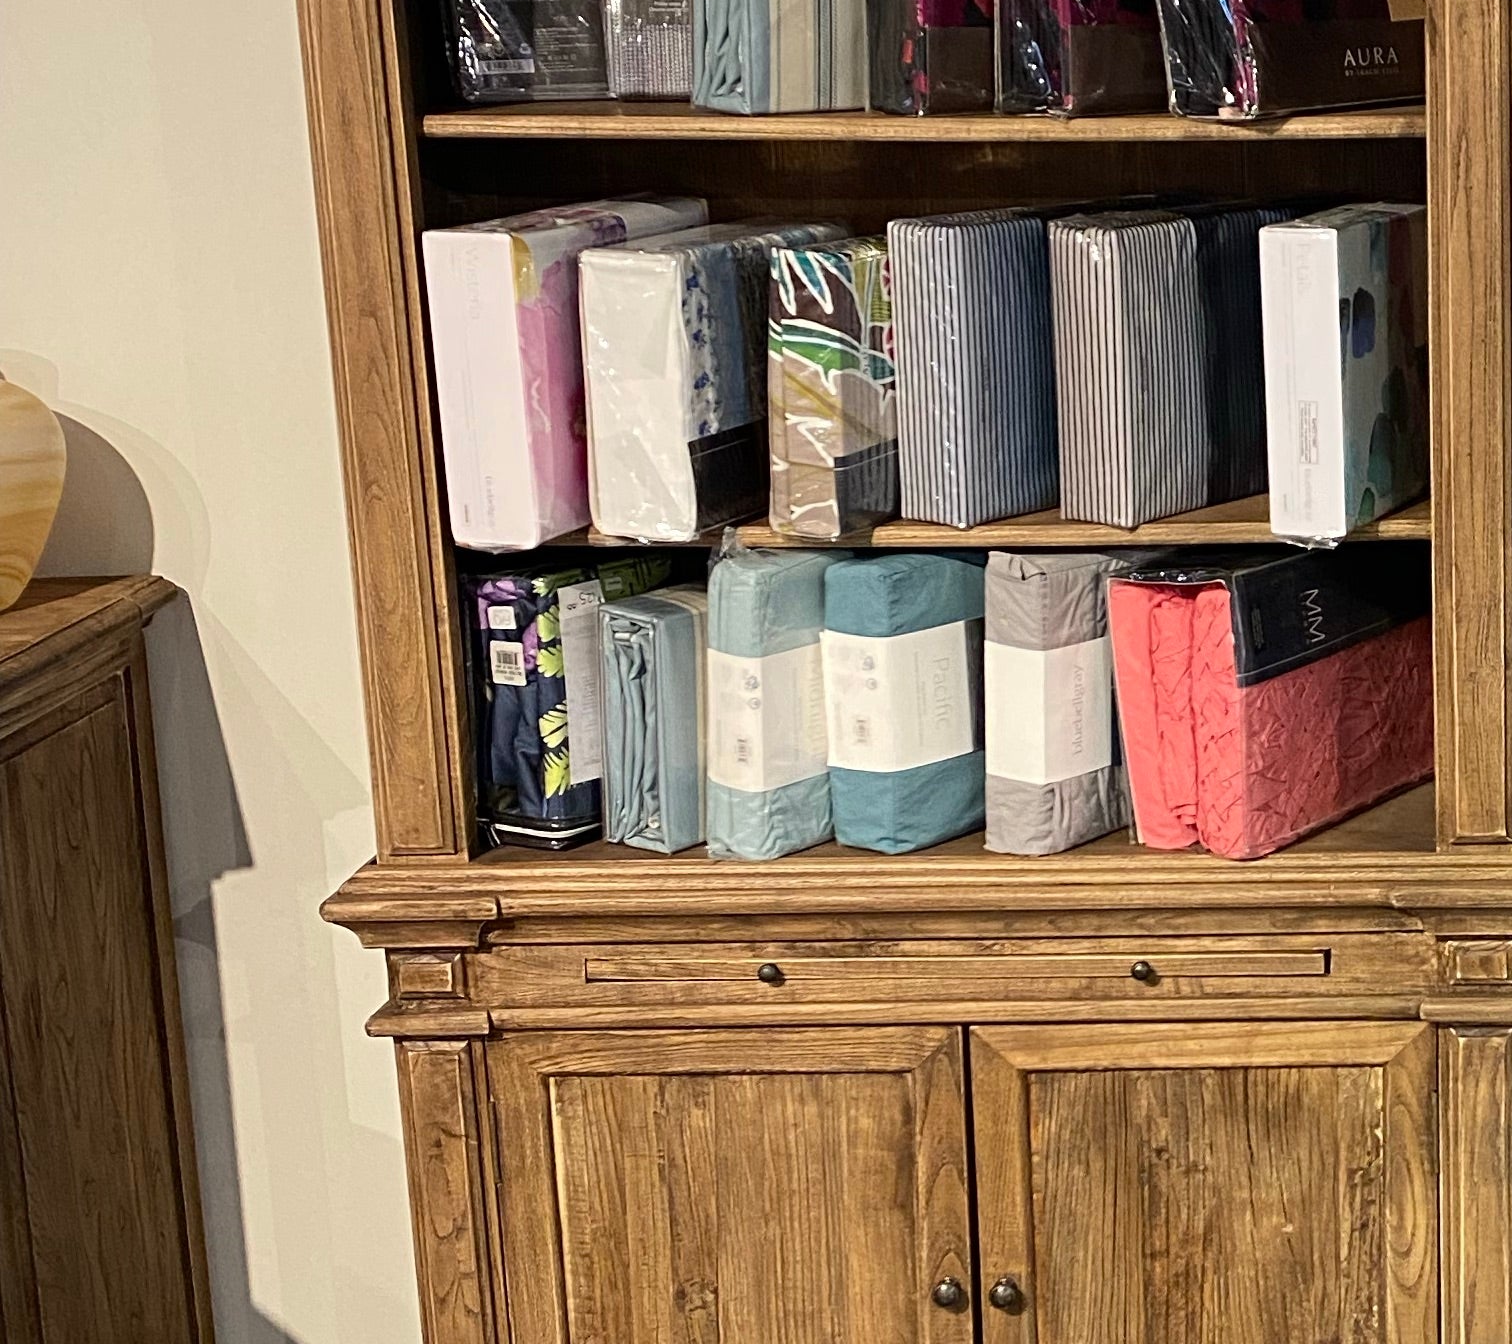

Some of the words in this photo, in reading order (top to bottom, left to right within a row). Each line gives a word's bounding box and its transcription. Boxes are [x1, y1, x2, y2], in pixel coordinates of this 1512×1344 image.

[1344, 46, 1399, 67] AURA
[1303, 589, 1326, 643] MM
[932, 657, 953, 731] Pacific
[1071, 664, 1085, 757] bluebellgray
